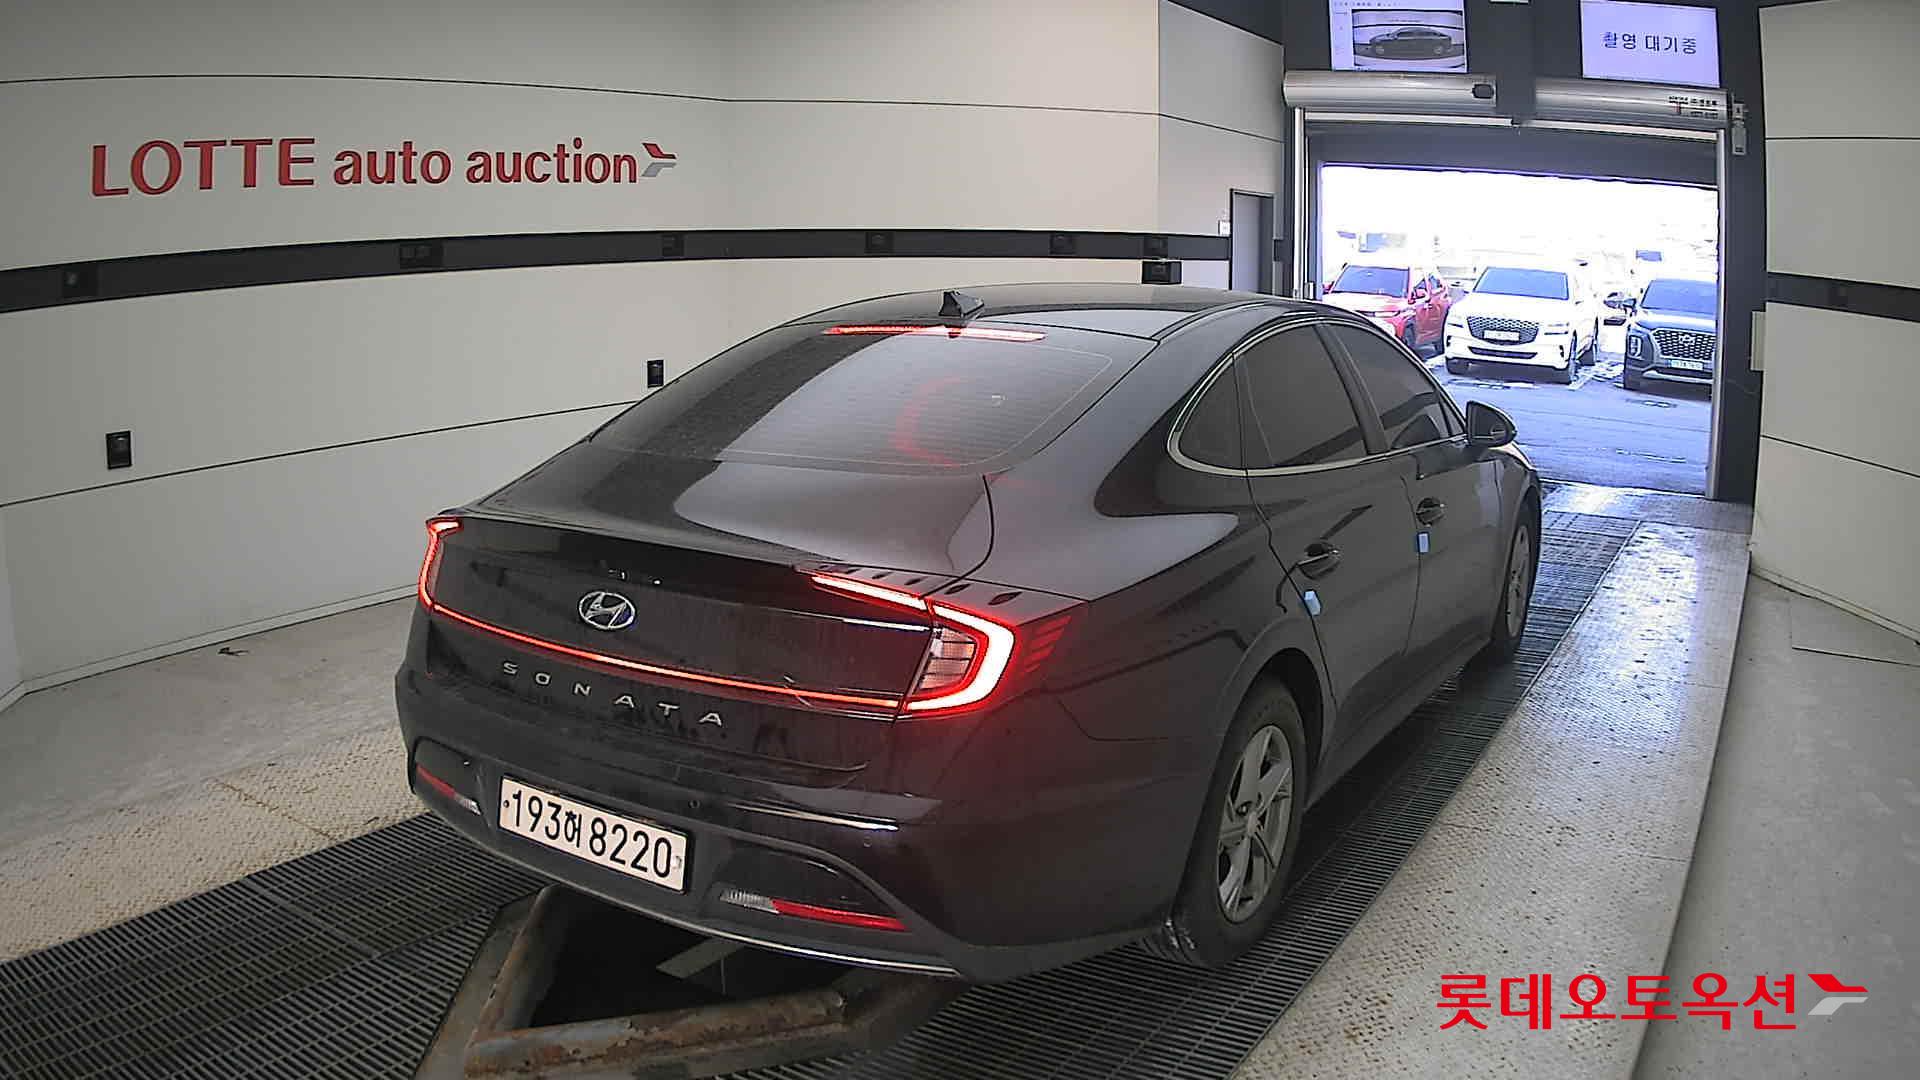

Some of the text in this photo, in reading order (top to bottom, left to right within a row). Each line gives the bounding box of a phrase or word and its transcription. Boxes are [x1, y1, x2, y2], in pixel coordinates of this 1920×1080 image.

[1645, 35, 1697, 55] 대기중
[91, 137, 637, 197] LOTTE auto auction
[502, 660, 724, 728] SONATA
